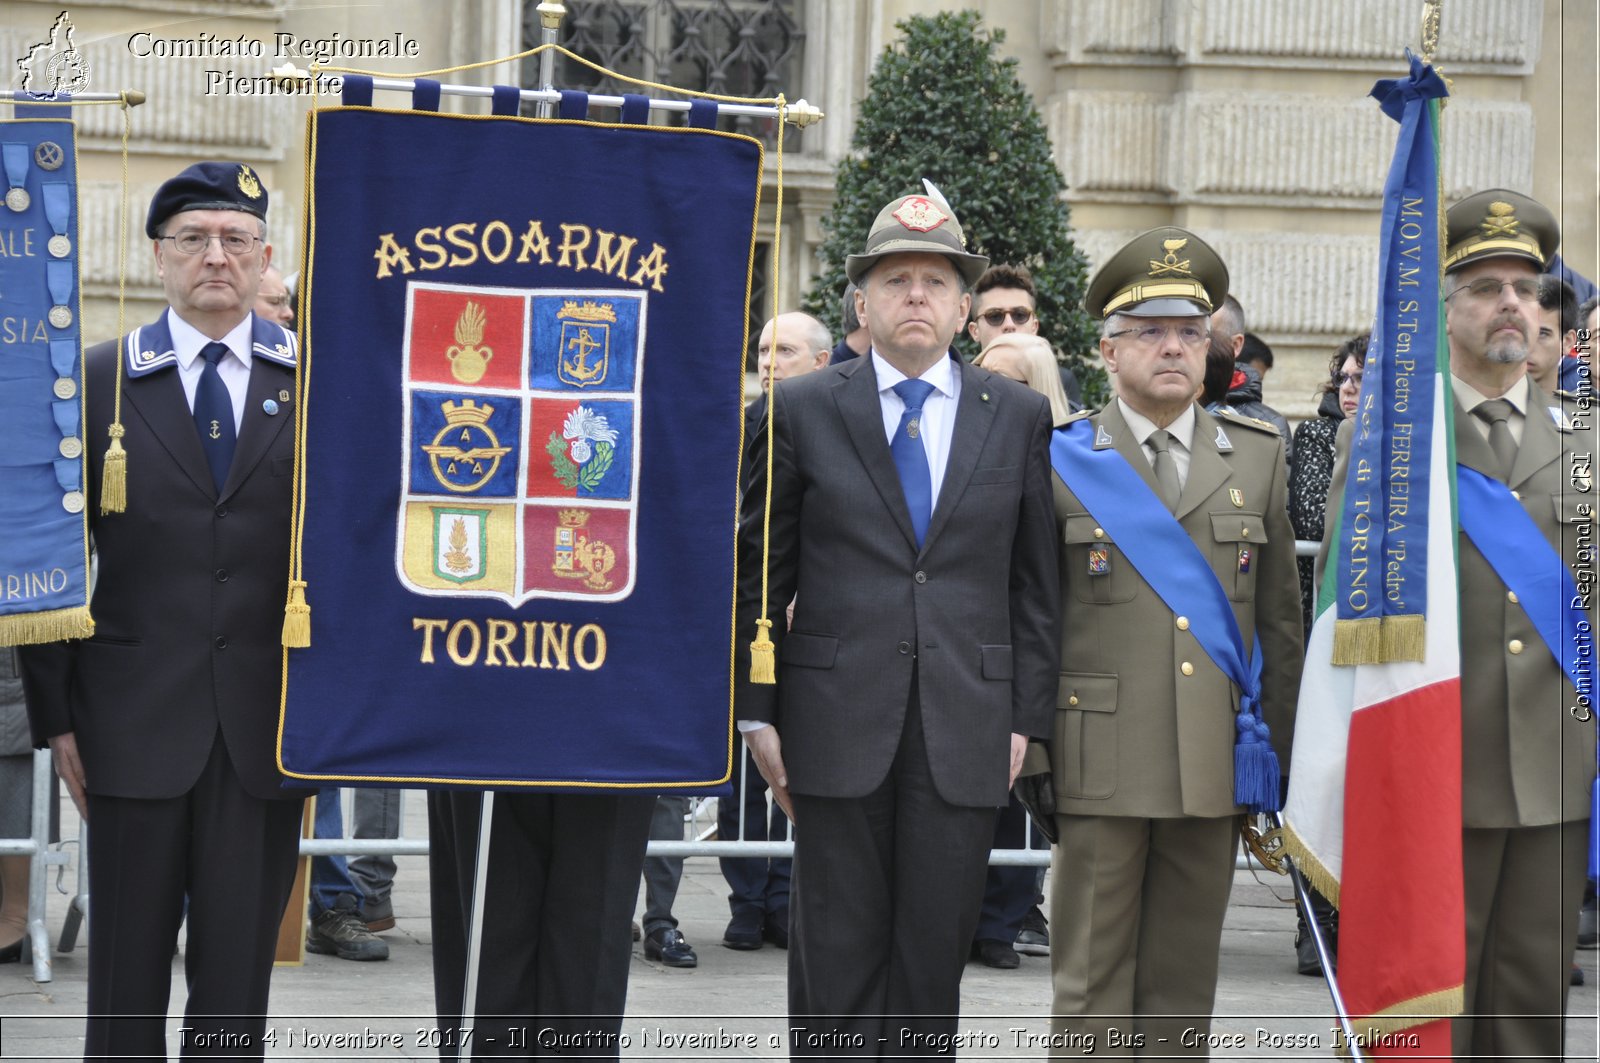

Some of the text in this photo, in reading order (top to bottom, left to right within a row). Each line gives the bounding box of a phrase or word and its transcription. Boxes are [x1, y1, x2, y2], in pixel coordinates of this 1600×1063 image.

[373, 220, 669, 292] ASSOARMA
[1398, 196, 1423, 292] M.O.V.M.
[1357, 458, 1371, 482] di
[1388, 422, 1412, 534] FERREIRA
[0, 568, 67, 600] RINO
[1349, 494, 1371, 612] TORINO
[1386, 540, 1406, 609] "Pedro"
[412, 617, 607, 671] TORINO
